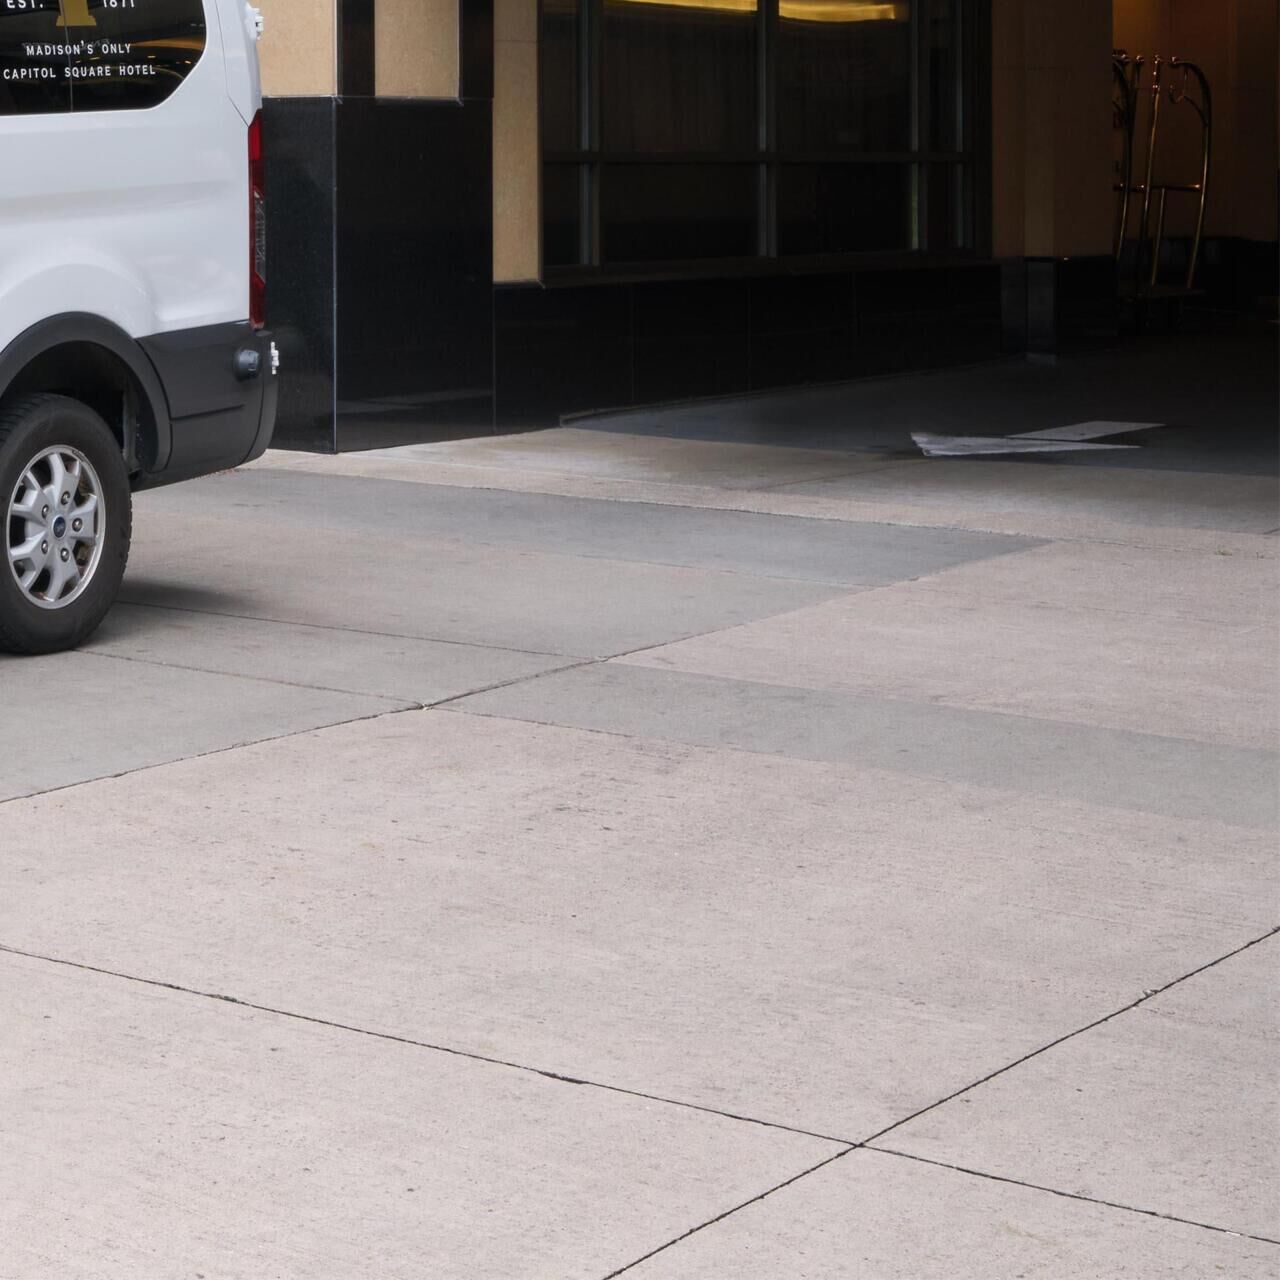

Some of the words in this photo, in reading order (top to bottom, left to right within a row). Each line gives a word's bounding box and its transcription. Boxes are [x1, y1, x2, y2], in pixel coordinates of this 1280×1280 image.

[26, 40, 94, 57] MADISON'S
[101, 43, 132, 54] ONLY
[3, 68, 57, 80] CAPITOL
[64, 66, 112, 78] SQUARE
[119, 64, 156, 75] HOTEL
